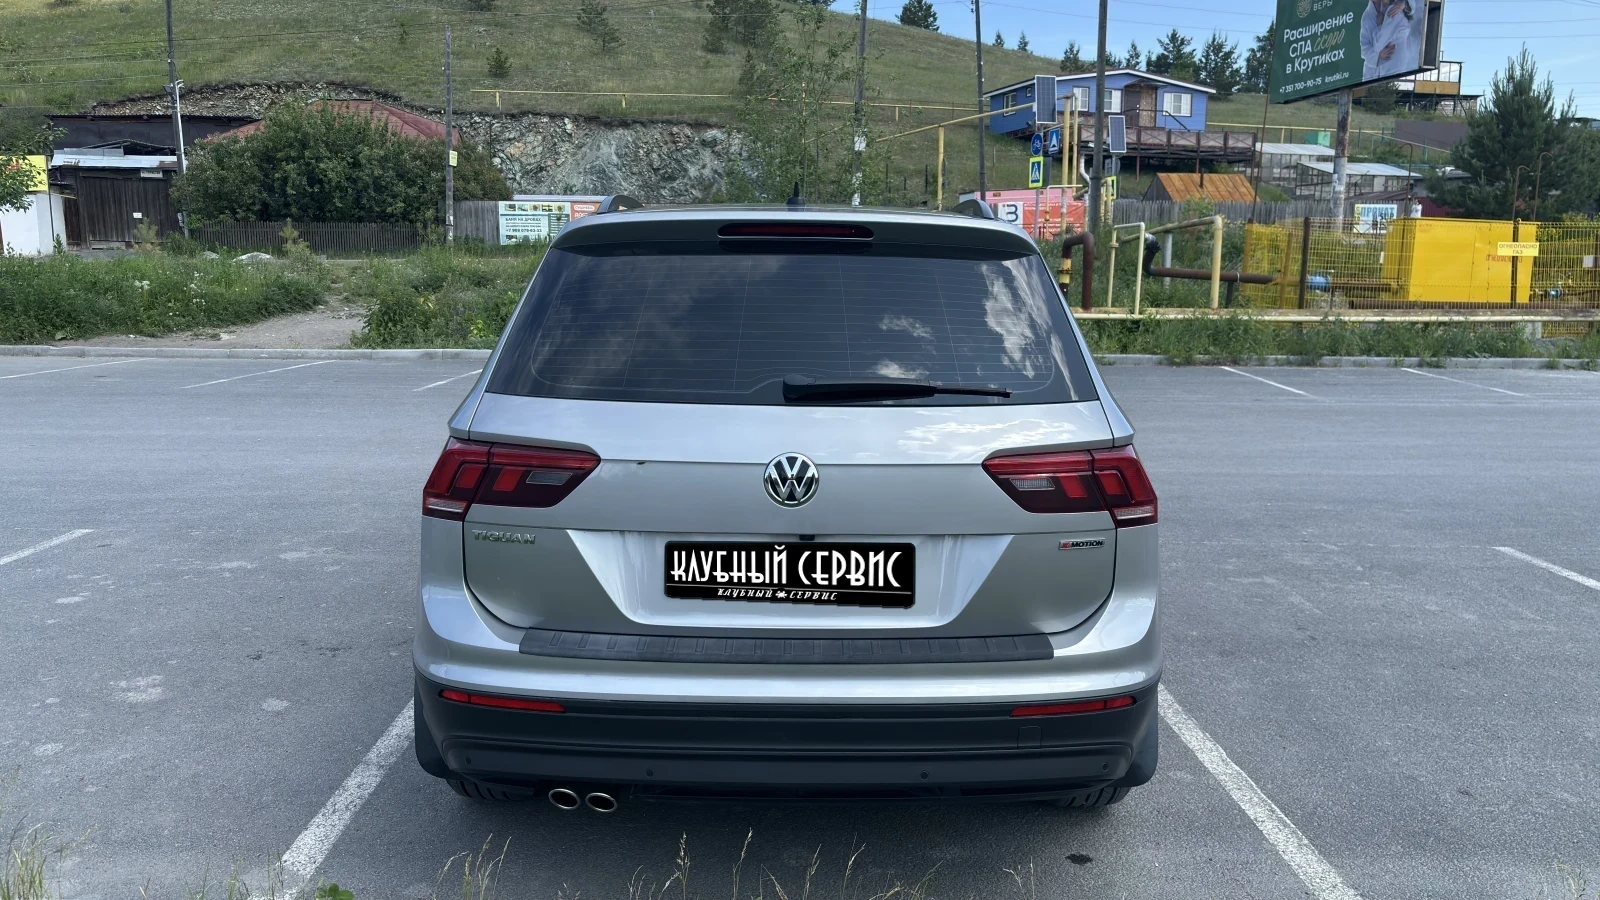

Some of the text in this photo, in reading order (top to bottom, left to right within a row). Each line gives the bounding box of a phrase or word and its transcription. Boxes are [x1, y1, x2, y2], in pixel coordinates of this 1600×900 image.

[1313, 0, 1333, 11] ВЕРЫ
[1283, 12, 1354, 43] Расширение
[1289, 39, 1312, 57] СПА
[1286, 48, 1345, 74] в Крутиках
[1325, 71, 1349, 83] krutiki.ru
[1360, 206, 1395, 218] ПРОКАТ
[471, 529, 536, 544] TIGUAN
